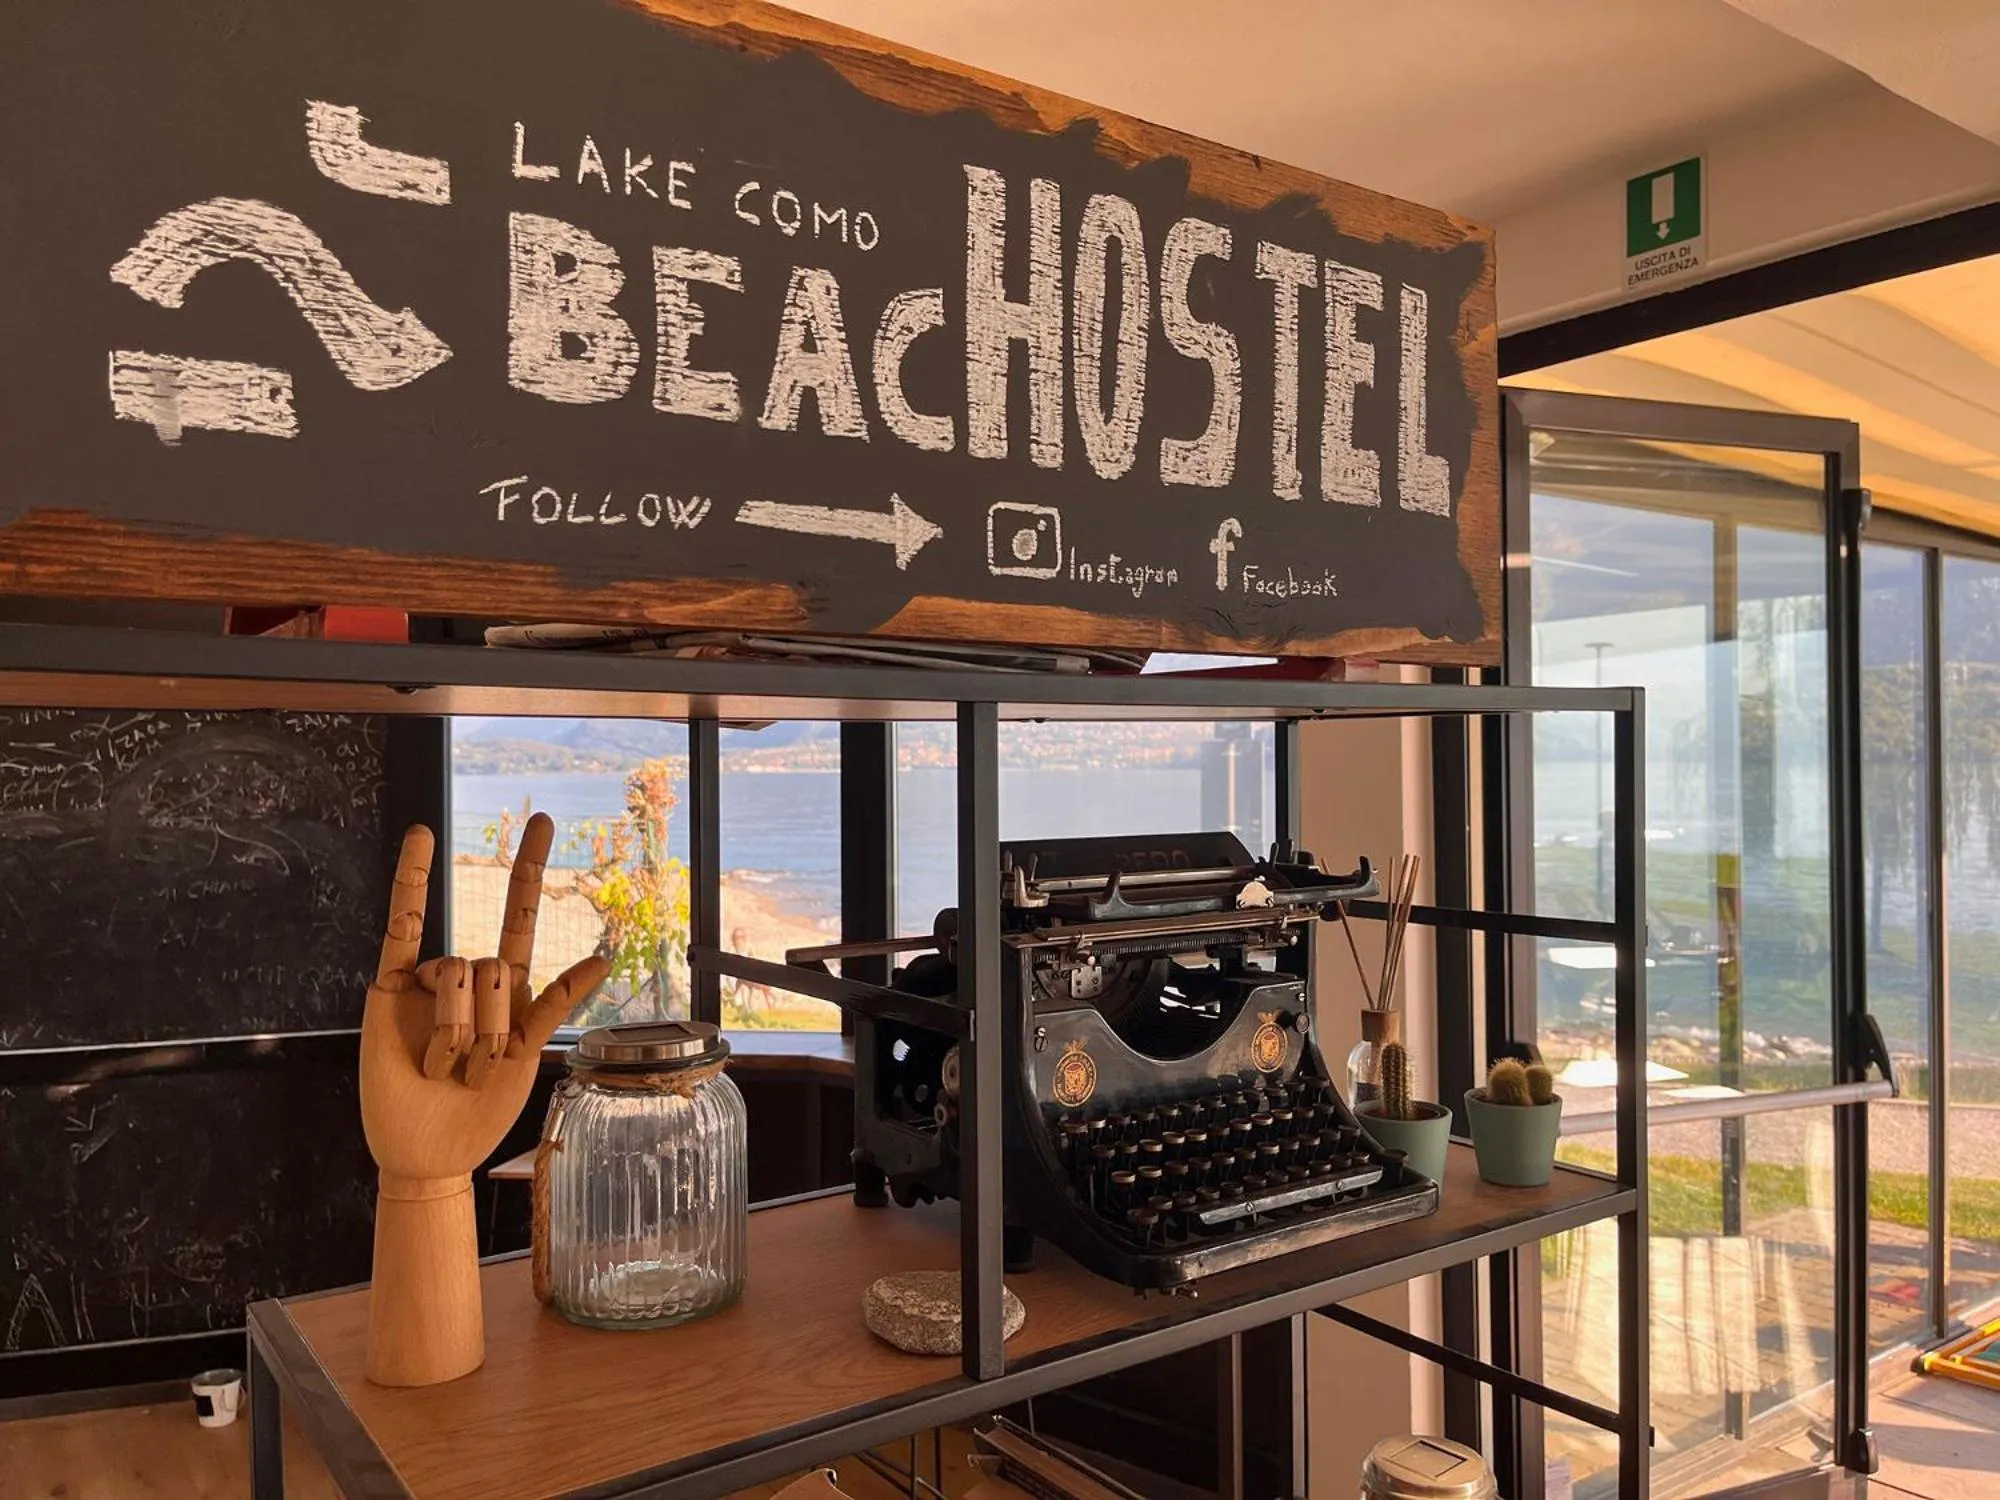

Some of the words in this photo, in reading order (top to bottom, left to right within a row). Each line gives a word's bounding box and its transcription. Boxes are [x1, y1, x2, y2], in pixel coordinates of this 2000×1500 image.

[511, 120, 697, 209] LAKE
[734, 180, 881, 252] COMO
[1628, 257, 1699, 286] EMERGENZA
[1635, 251, 1676, 270] USCITA
[1680, 245, 1691, 257] DI
[479, 475, 713, 531] FOLLOW
[1069, 546, 1179, 598] Instagram
[1242, 564, 1339, 598] Facebook
